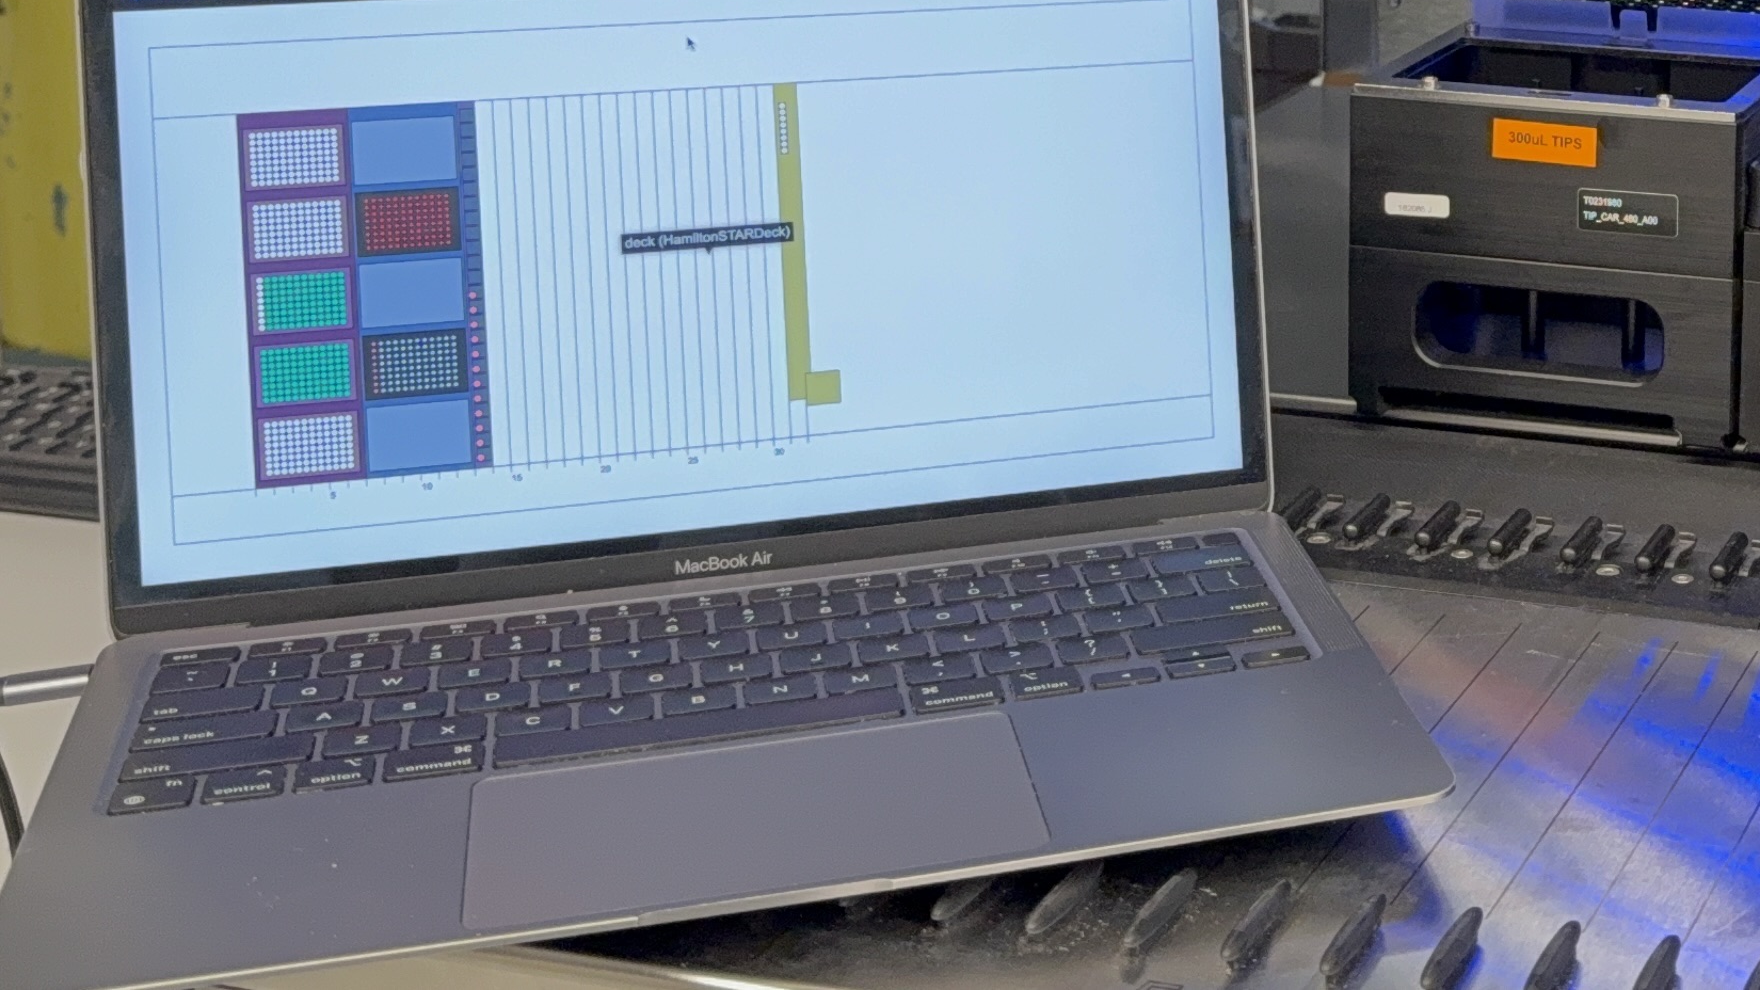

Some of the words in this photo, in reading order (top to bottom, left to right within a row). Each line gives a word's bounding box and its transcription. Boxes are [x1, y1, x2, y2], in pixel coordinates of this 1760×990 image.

[1508, 131, 1548, 146] 300uL
[1552, 135, 1582, 149] TIPS
[624, 235, 656, 249] deck
[658, 225, 791, 248] (HamiltonSTARDeck)
[674, 553, 748, 575] MacBook
[751, 550, 773, 566] Air
[1205, 556, 1242, 565] delete
[1230, 600, 1269, 610] return
[1252, 624, 1282, 634] shift
[785, 631, 798, 639] U
[963, 634, 976, 642] L
[707, 641, 720, 649] Y
[886, 644, 899, 652] K
[628, 650, 641, 658] T
[728, 663, 744, 672] H
[468, 668, 480, 677] E
[382, 676, 403, 686] W
[852, 674, 870, 683] M
[773, 685, 788, 694] N
[1024, 681, 1068, 692] option
[485, 692, 500, 701] D
[925, 691, 994, 705] command
[402, 701, 416, 711] S
[608, 706, 624, 715] V
[153, 707, 179, 715] tab
[316, 712, 332, 721] A
[525, 716, 541, 725] C
[440, 725, 455, 734] X
[144, 736, 180, 746] caps
[183, 731, 215, 740] lock
[354, 735, 369, 745] Z
[134, 764, 171, 774] shift
[396, 757, 472, 773] command
[311, 772, 361, 784] option
[213, 782, 271, 795] control
